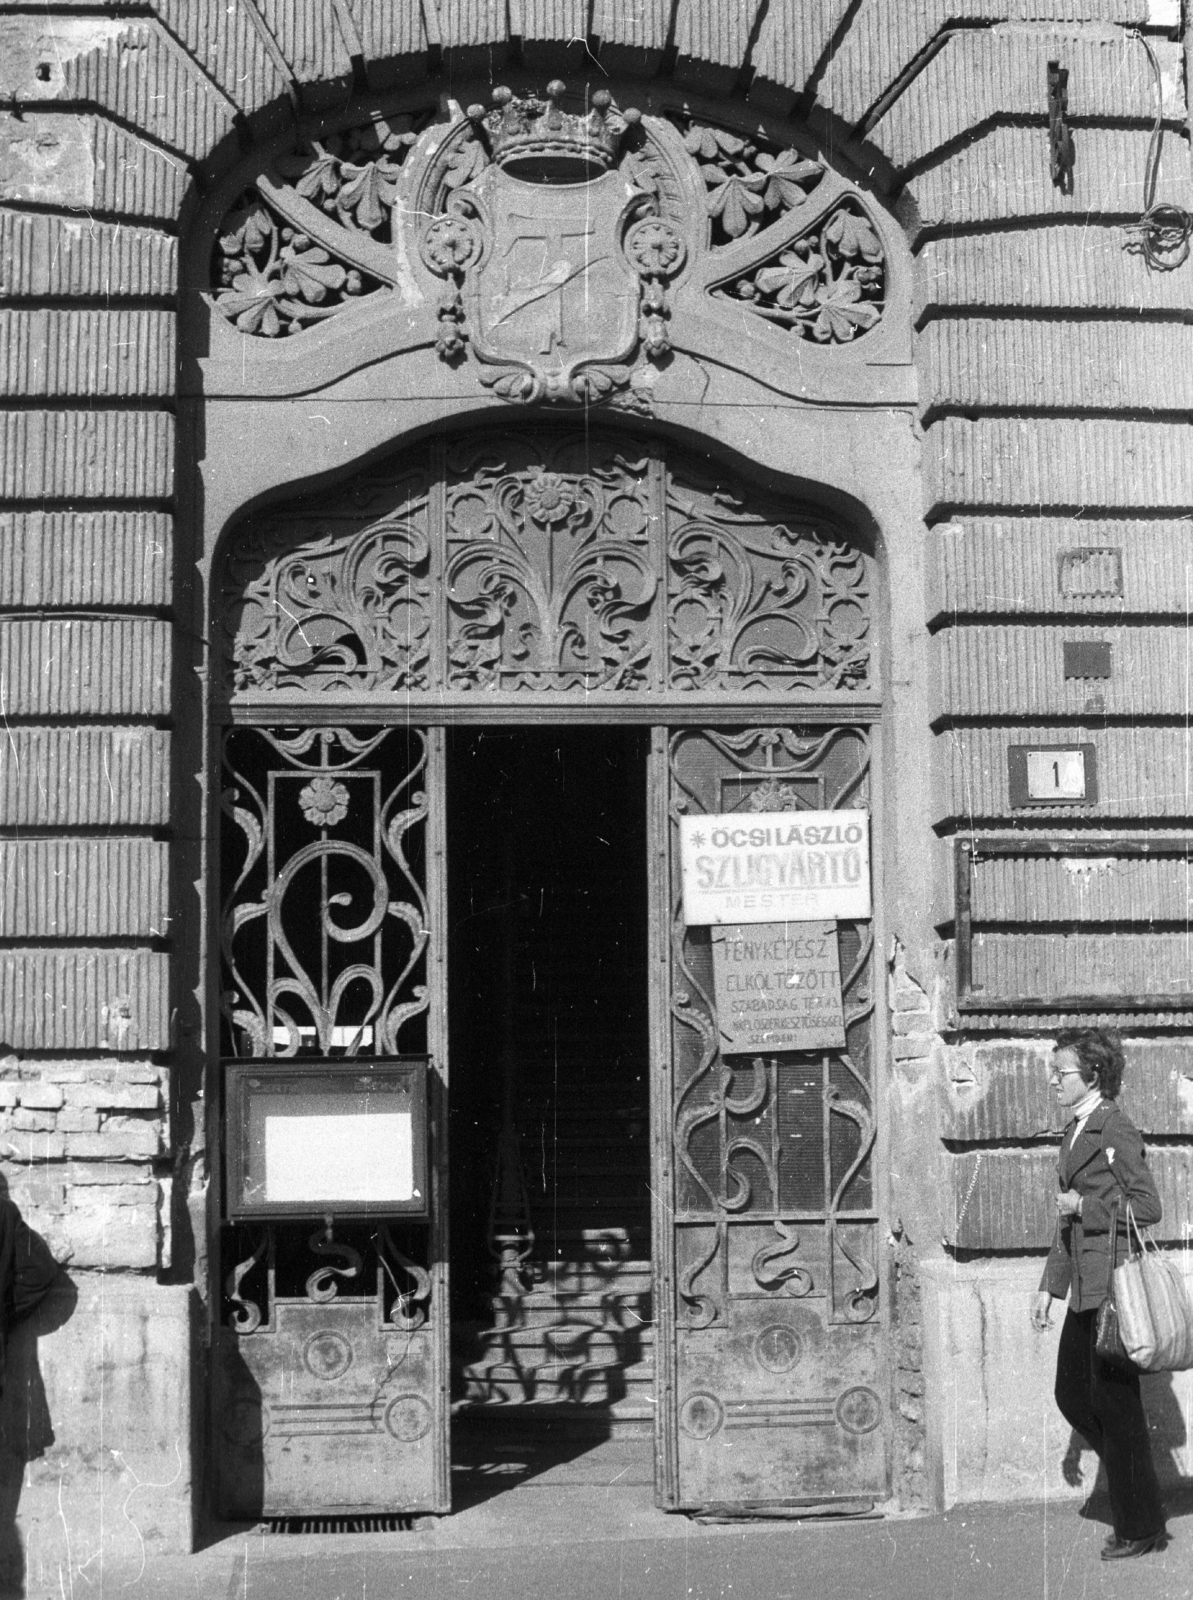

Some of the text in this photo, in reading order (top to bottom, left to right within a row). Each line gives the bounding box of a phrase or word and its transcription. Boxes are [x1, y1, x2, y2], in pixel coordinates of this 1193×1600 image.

[1053, 761, 1060, 787] 1
[711, 827, 772, 848] ÖCSI
[725, 893, 819, 909] MESTER
